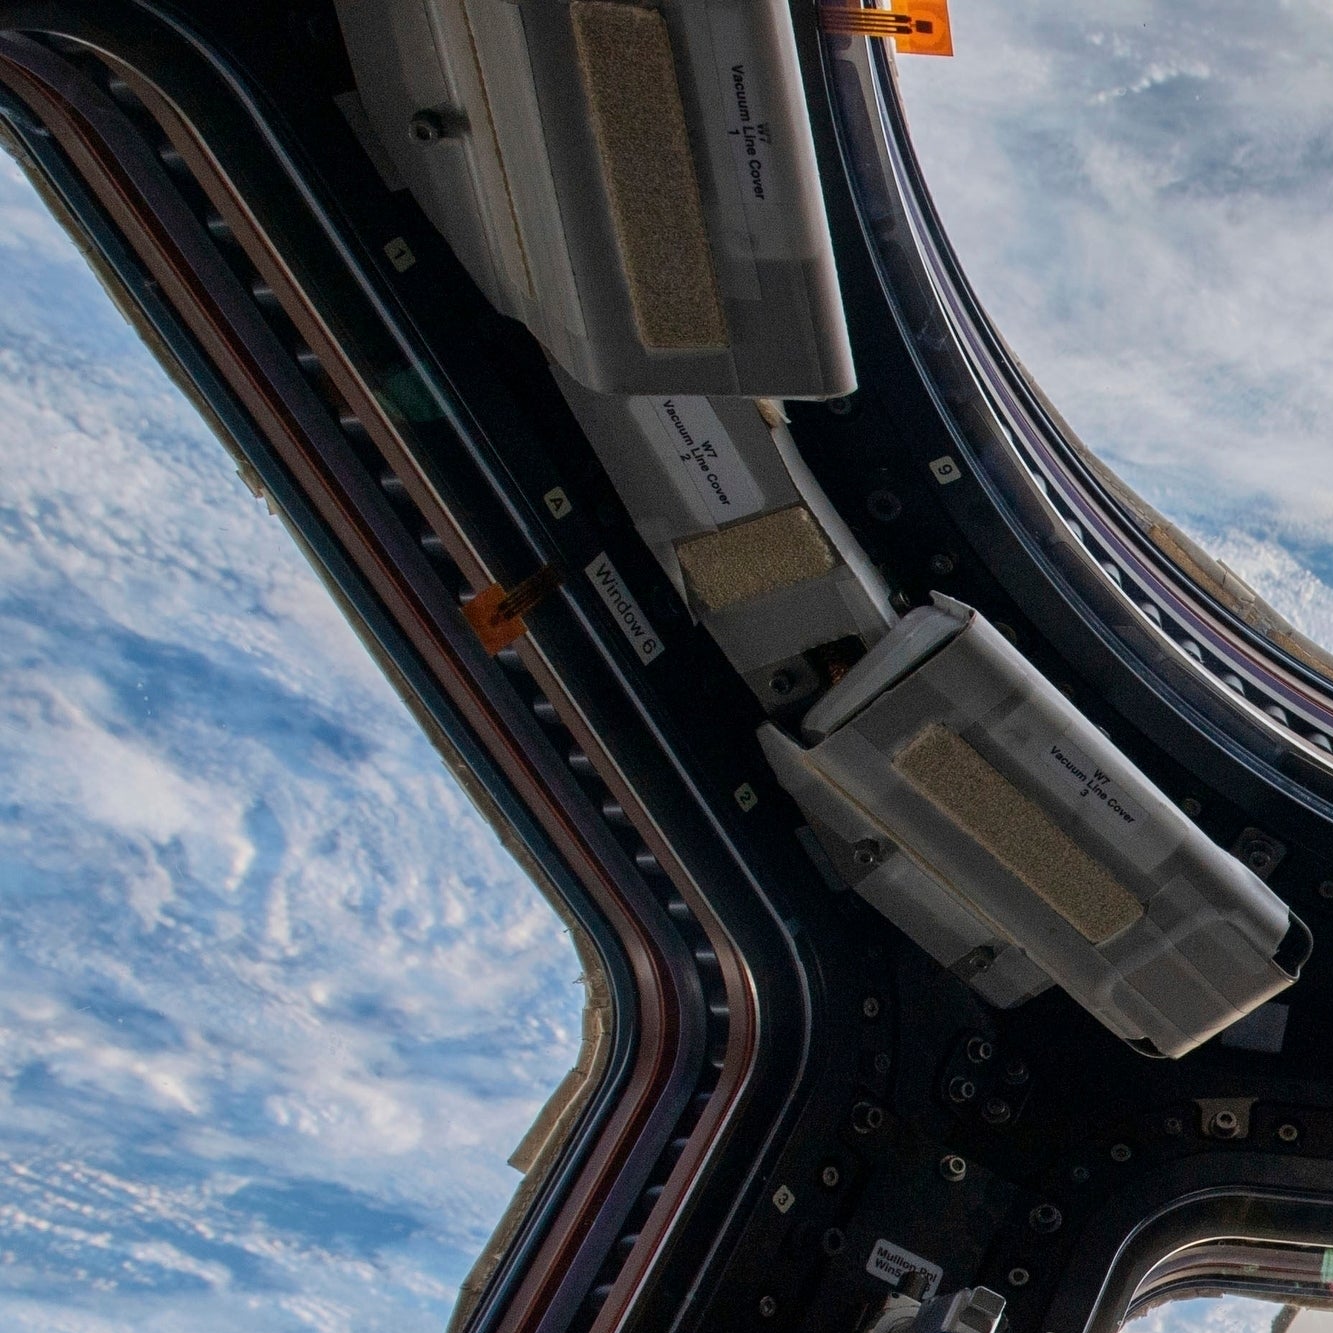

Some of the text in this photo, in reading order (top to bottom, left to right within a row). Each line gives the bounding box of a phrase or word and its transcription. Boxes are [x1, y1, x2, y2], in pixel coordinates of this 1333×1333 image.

[731, 64, 765, 200] Vacuum Line Cover
[663, 399, 731, 506] Vacuum Line Cover
[701, 439, 718, 459] W7
[595, 562, 657, 654] Window 6
[1050, 745, 1136, 823] Vacuum Line Cover
[1093, 769, 1111, 786] W7
